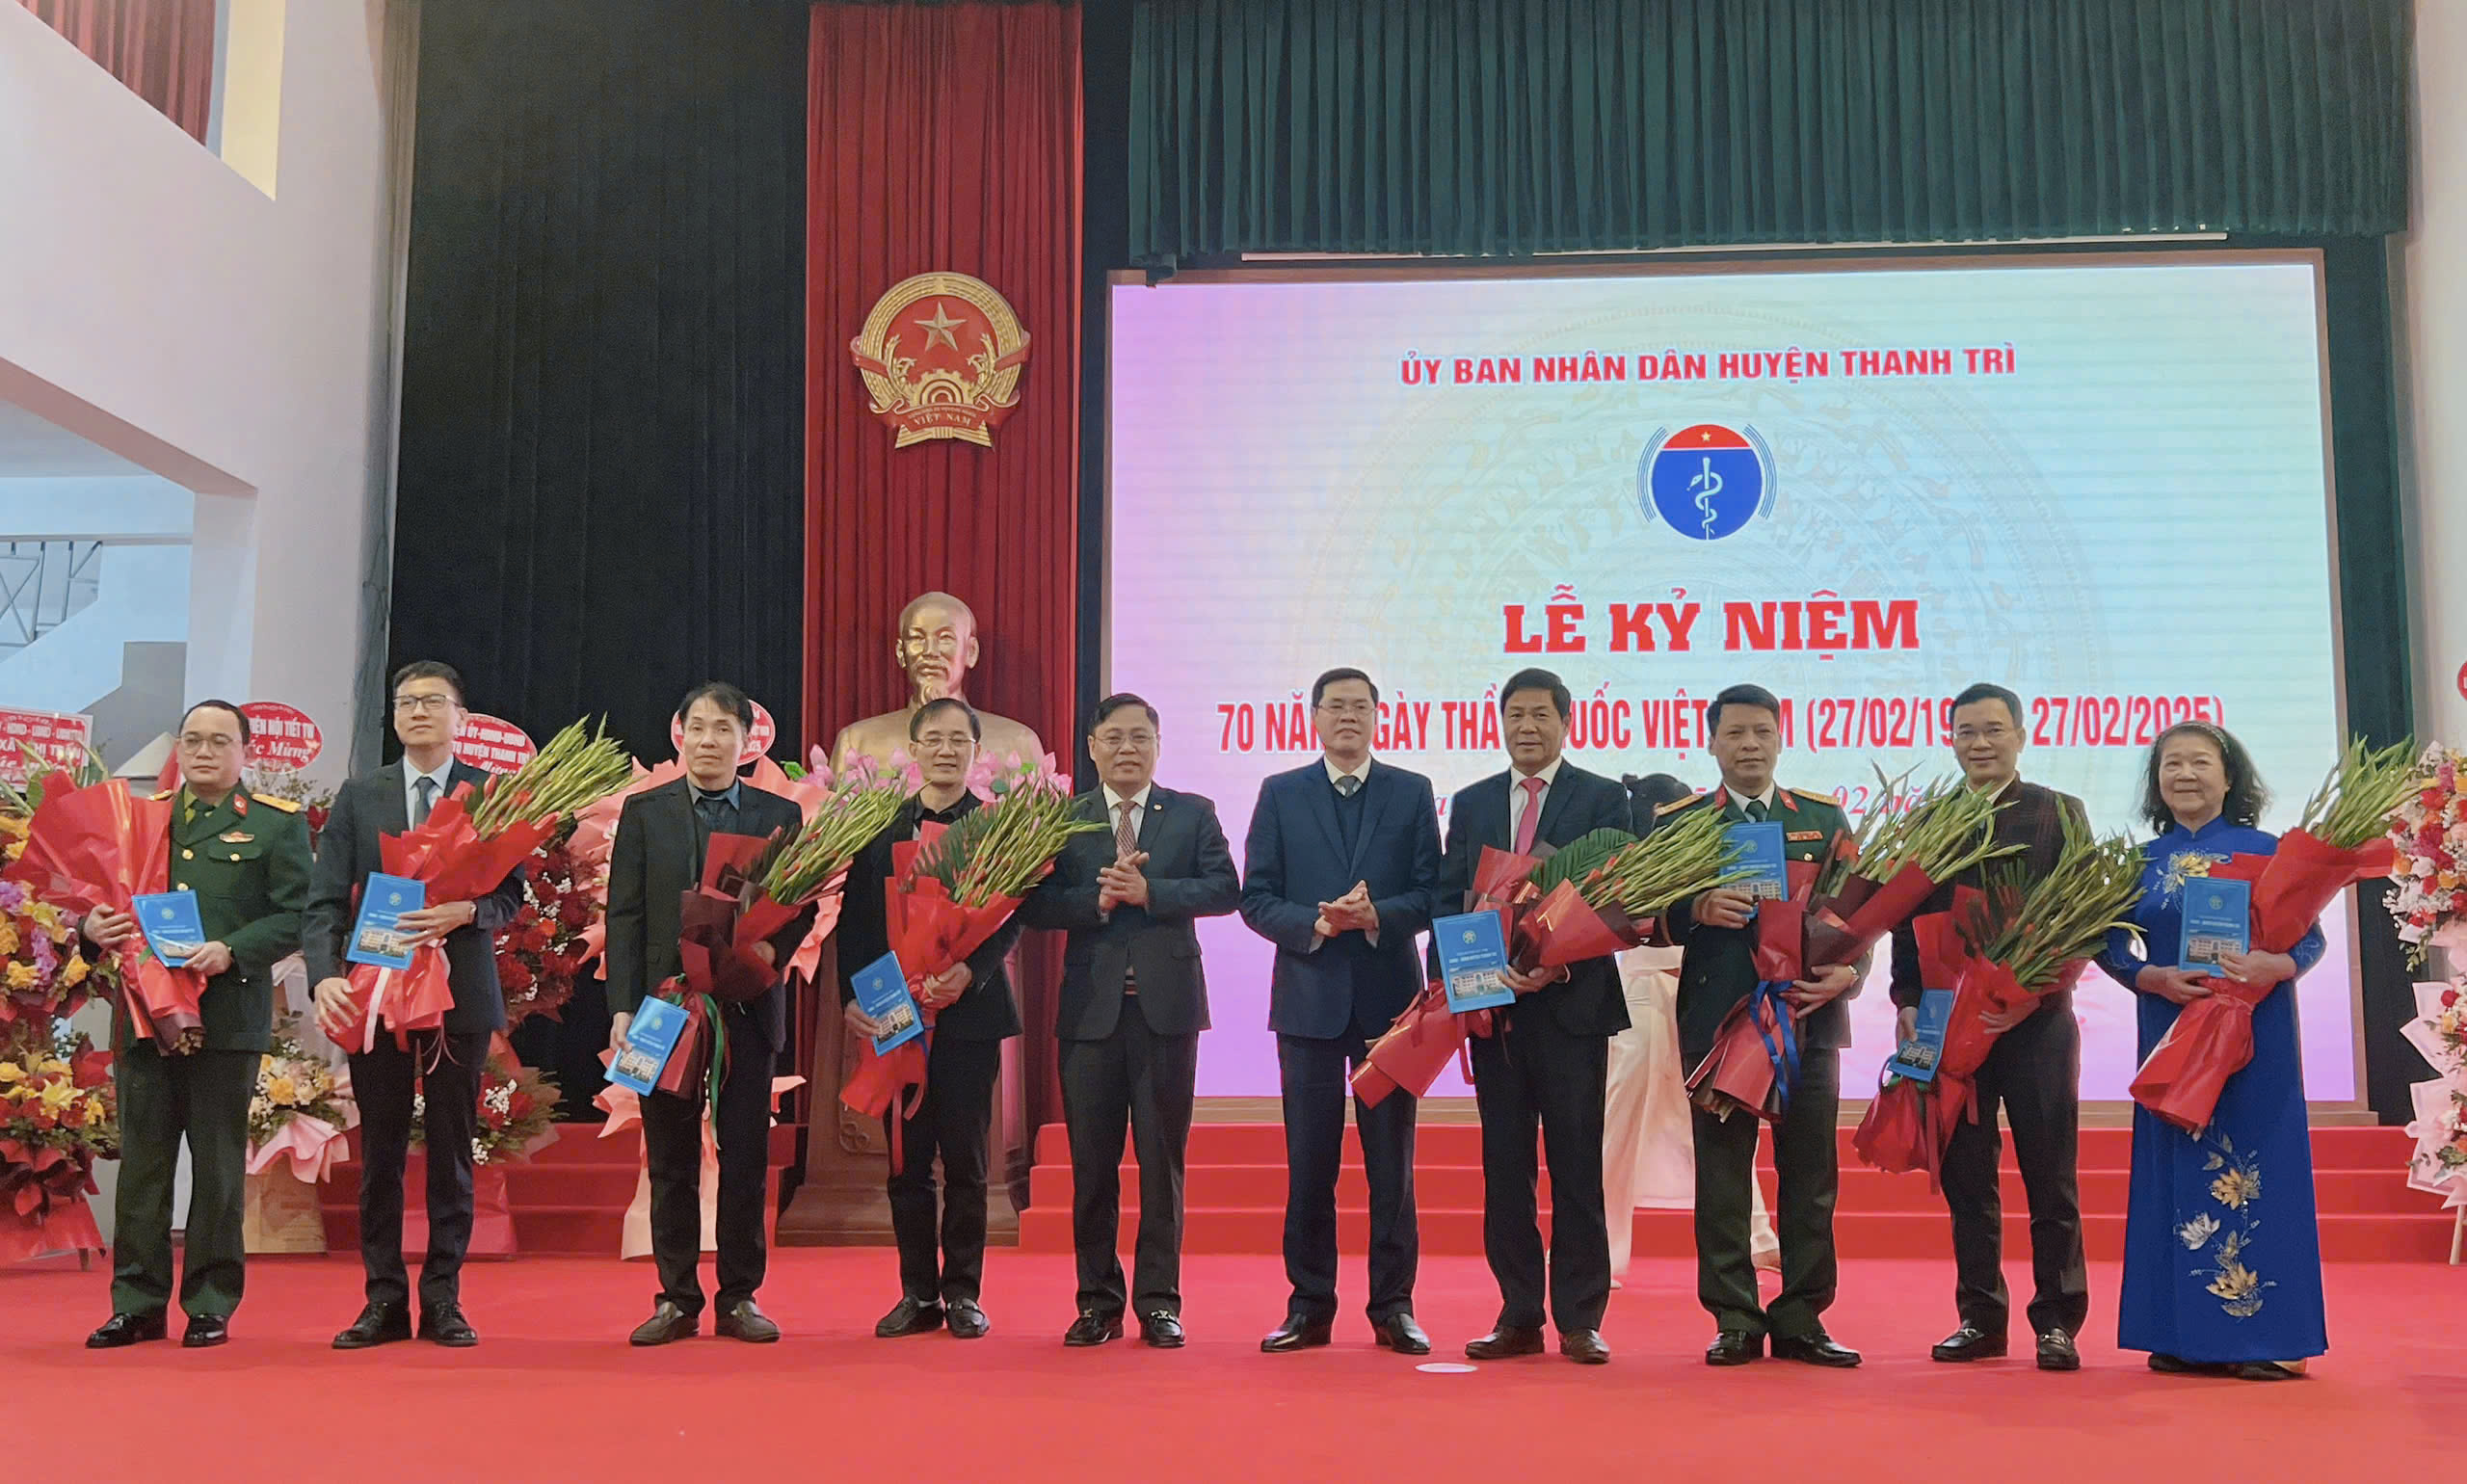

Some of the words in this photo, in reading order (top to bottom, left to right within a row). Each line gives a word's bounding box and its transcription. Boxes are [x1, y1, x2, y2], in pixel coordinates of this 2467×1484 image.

[1400, 350, 1442, 384] ỦY
[1453, 358, 1521, 384] BAN
[1533, 350, 1626, 383] NHÂN
[1638, 348, 1707, 382] DÂN
[1719, 345, 1828, 384] HUYỆN
[1840, 350, 1952, 376] THANH
[1962, 341, 2016, 374] TRÌ
[1503, 584, 1586, 653] LỄ
[1609, 588, 1701, 652] KỶ
[1723, 589, 1920, 660] NIỆM
[1217, 703, 1253, 752] 70
[1372, 690, 1432, 751] GÀY
[1442, 682, 1500, 750] THẦ
[1561, 681, 1631, 750] UỐC
[1642, 688, 1709, 759] VIỆT
[1807, 697, 1954, 754] (27/02/19
